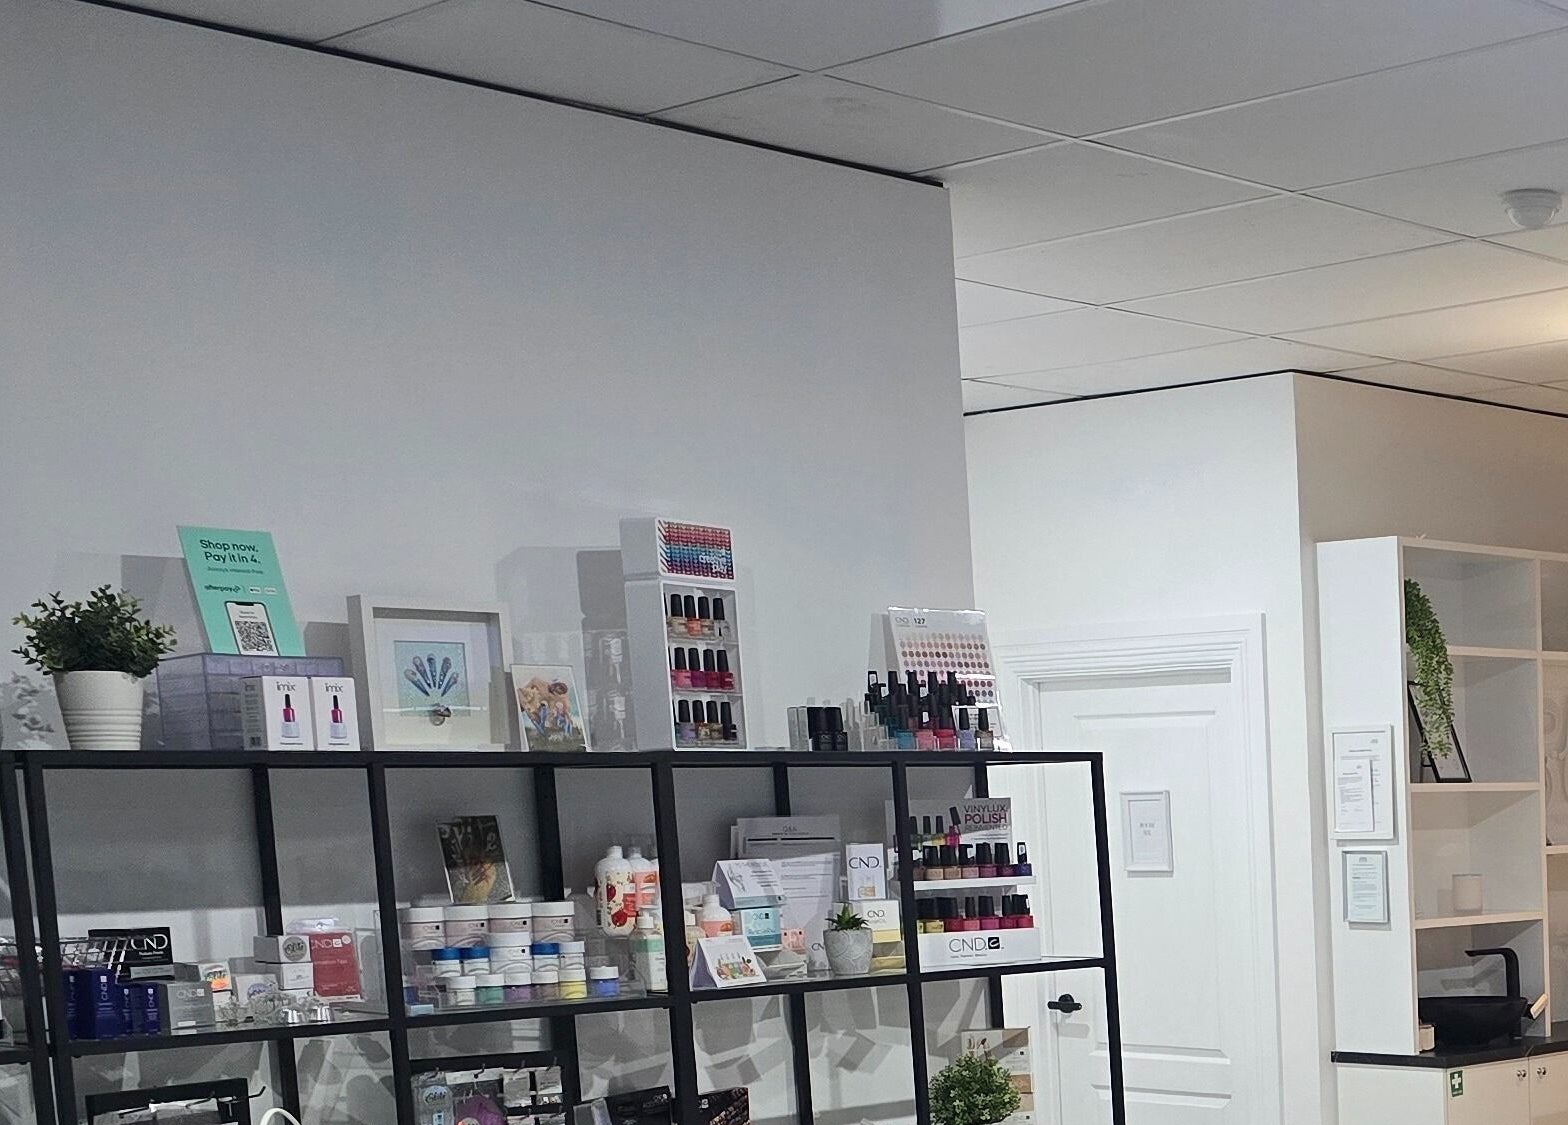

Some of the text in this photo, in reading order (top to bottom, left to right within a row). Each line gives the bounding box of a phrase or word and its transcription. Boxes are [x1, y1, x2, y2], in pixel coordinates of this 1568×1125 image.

[199, 539, 259, 553] Shop now.
[204, 551, 261, 564] Pay it in 4.
[276, 681, 296, 691] imix
[324, 683, 343, 693] imix
[964, 805, 1006, 813] VINYLUX
[965, 813, 1007, 824] POLISH
[848, 856, 880, 869] CND
[867, 910, 886, 918] CND
[811, 942, 825, 952] CN
[949, 937, 987, 953] CND
